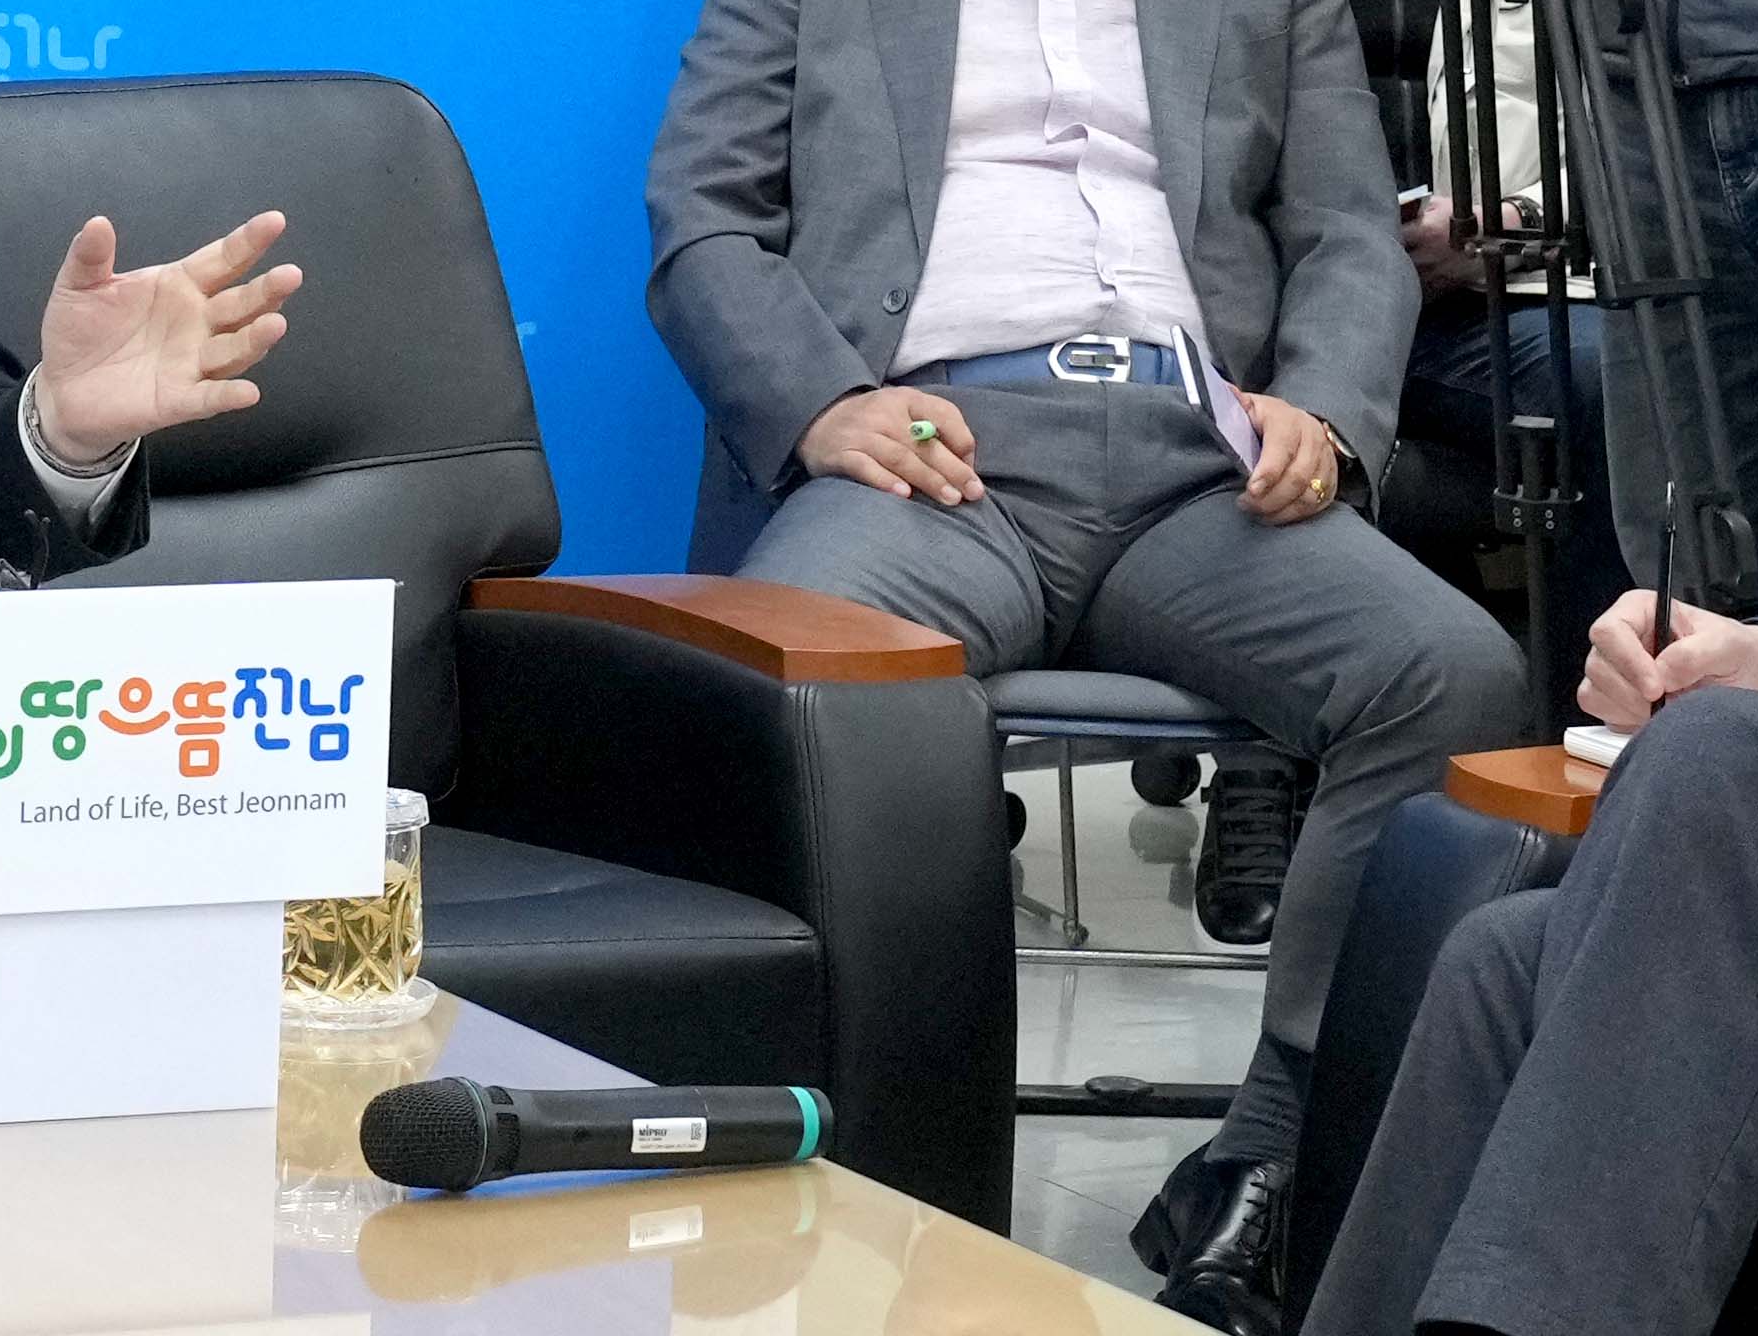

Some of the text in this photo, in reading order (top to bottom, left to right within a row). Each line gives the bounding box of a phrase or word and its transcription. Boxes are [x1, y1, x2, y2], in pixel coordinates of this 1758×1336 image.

[20, 791, 346, 824] Land of Life, Best Jeonnam
